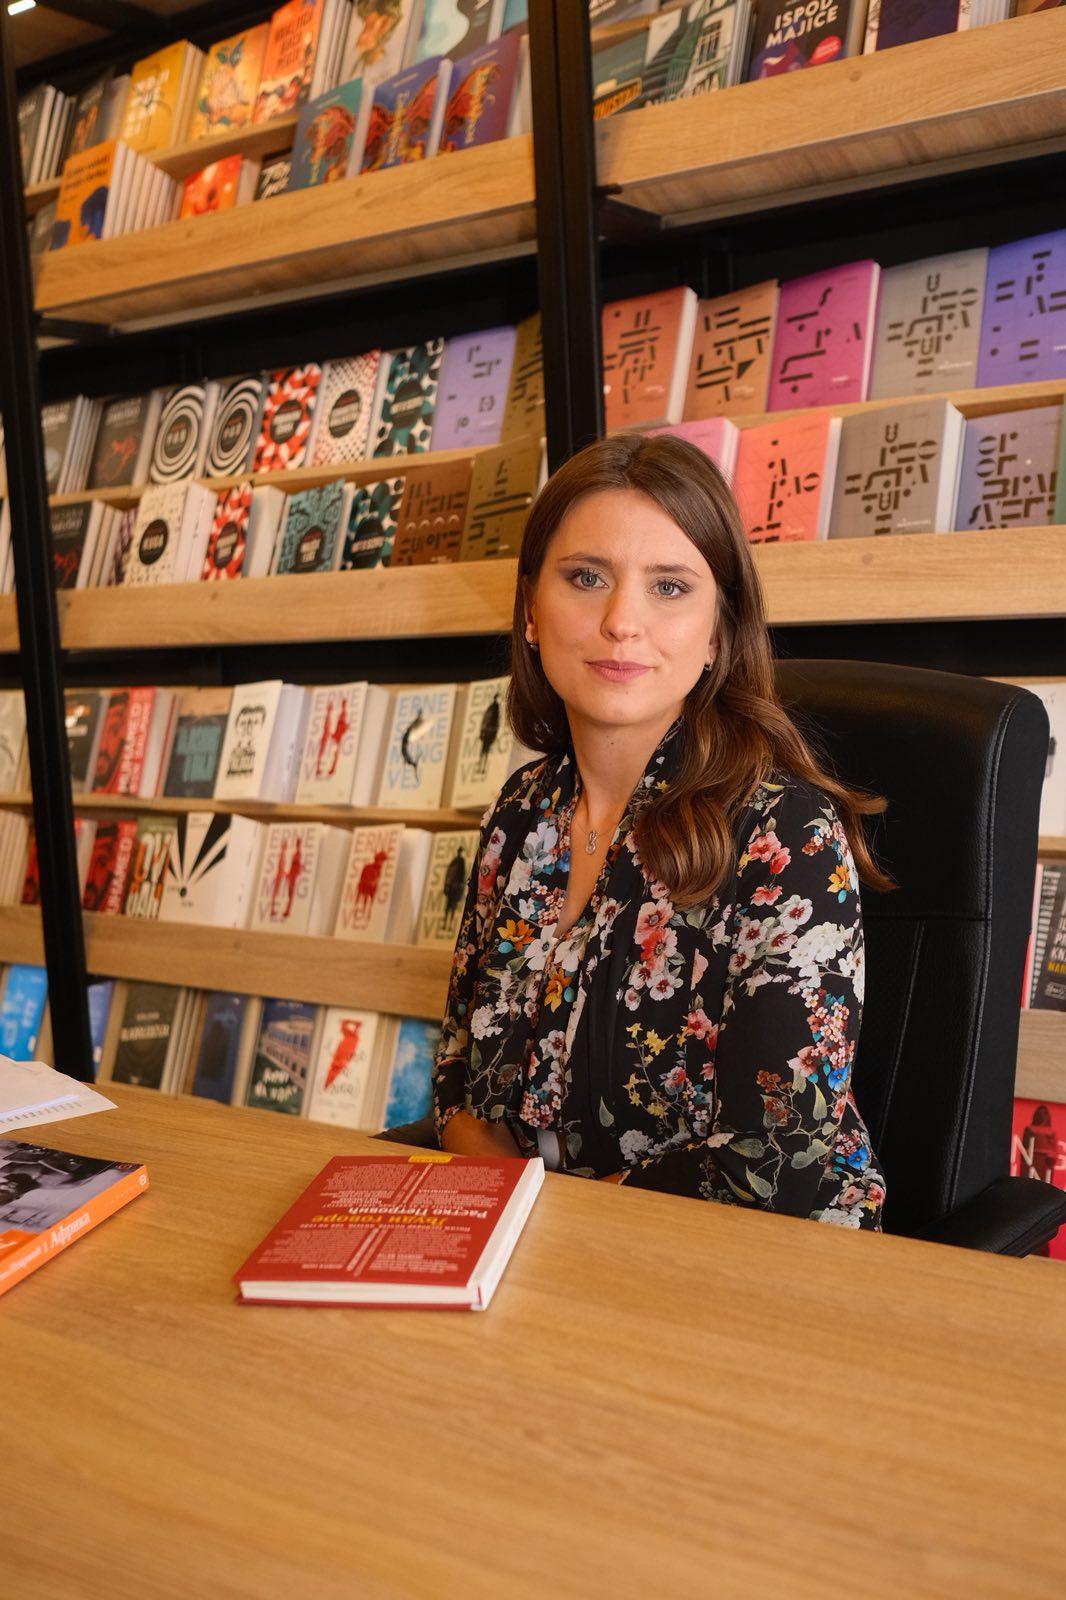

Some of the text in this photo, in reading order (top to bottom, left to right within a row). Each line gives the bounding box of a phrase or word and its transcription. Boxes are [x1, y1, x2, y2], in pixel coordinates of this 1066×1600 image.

[765, 4, 839, 49] MAJICE
[774, 0, 834, 31] ISPOD
[399, 692, 449, 717] ERNE
[311, 1213, 382, 1224] говоре
[432, 1207, 487, 1219] Растко
